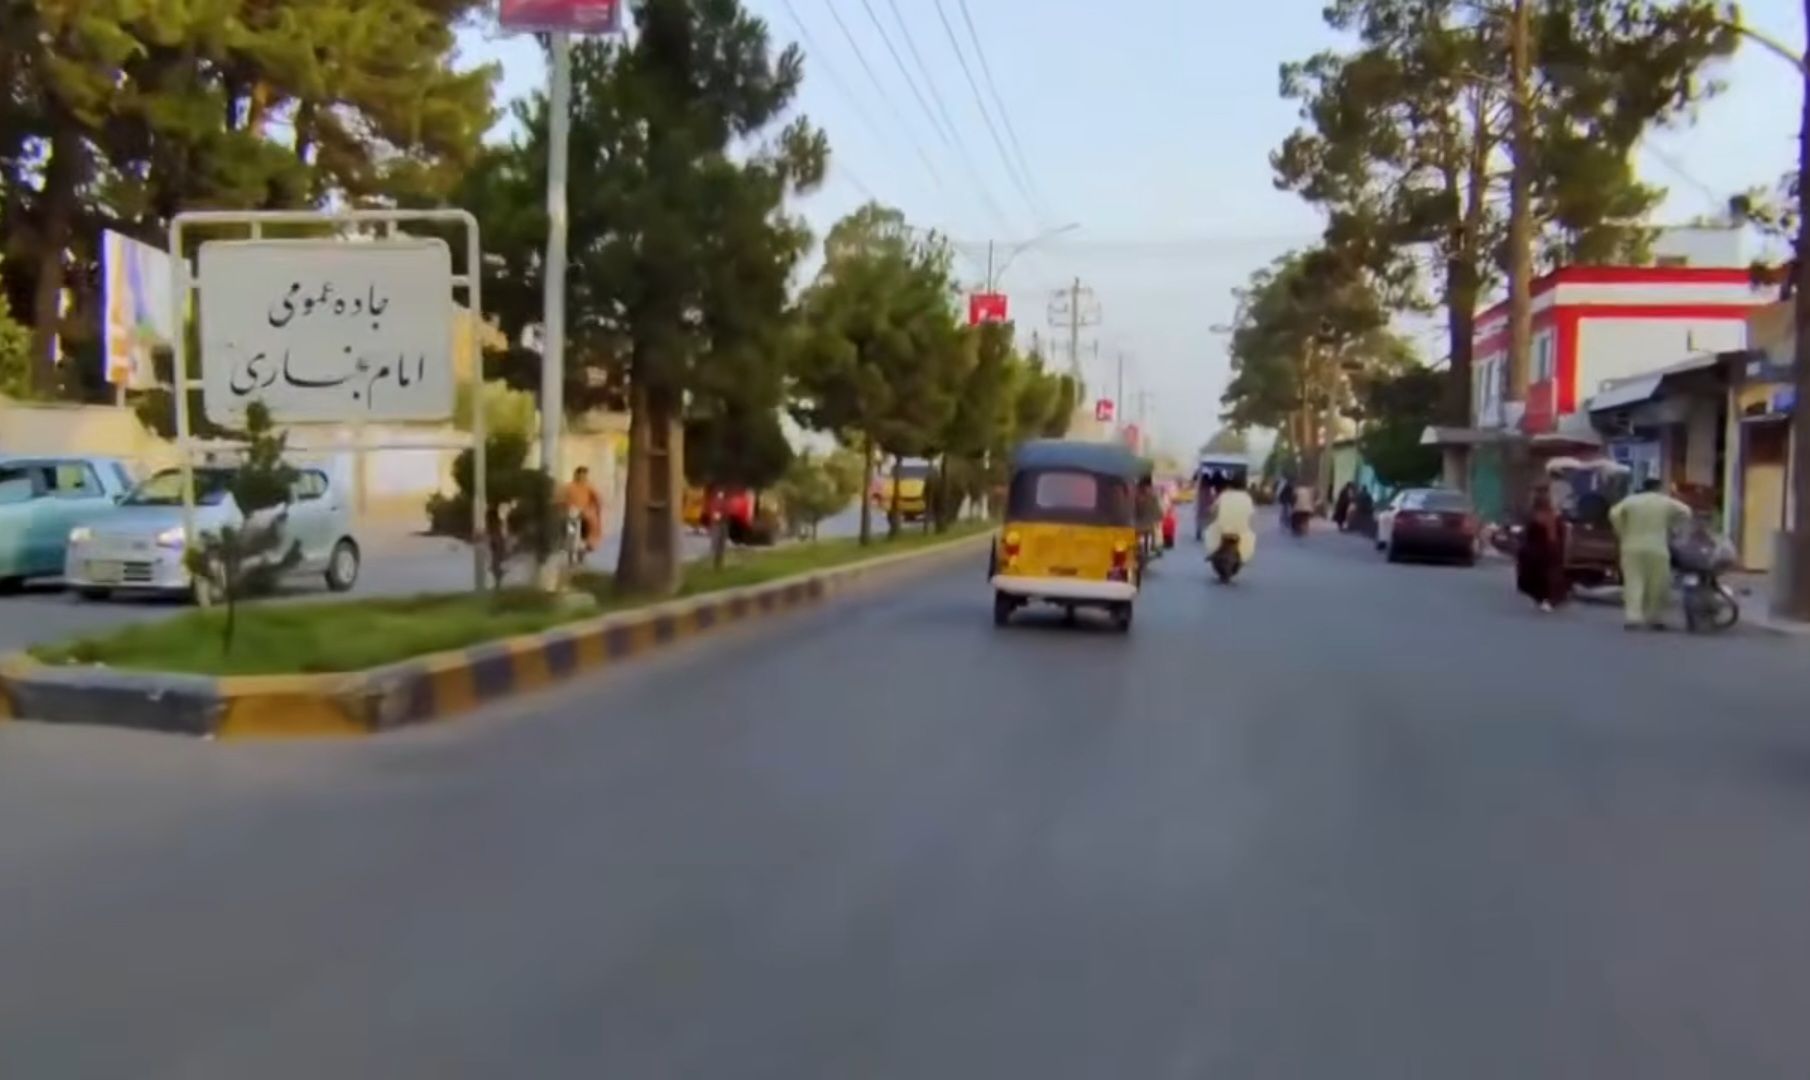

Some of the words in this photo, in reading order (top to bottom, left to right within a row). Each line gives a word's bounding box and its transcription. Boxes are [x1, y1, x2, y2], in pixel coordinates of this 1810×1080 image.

[268, 282, 333, 328] عمومی
[334, 282, 389, 330] جاده
[230, 346, 369, 400] بخاری
[368, 353, 424, 410] امام
